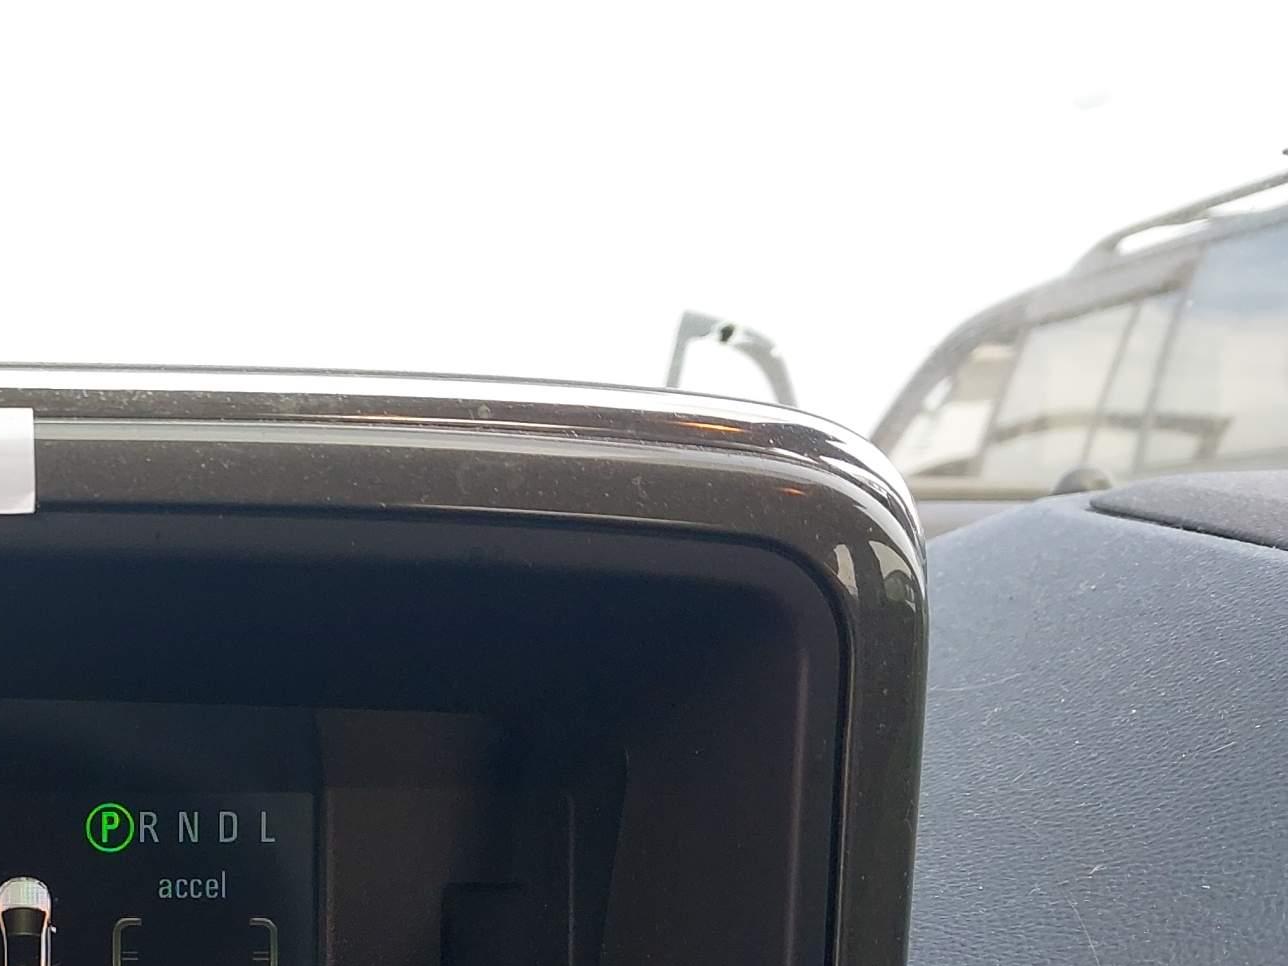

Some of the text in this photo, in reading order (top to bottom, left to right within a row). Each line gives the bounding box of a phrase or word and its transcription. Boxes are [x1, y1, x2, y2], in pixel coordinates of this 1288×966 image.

[101, 811, 276, 844] P R N D L
[158, 871, 227, 900] accel
